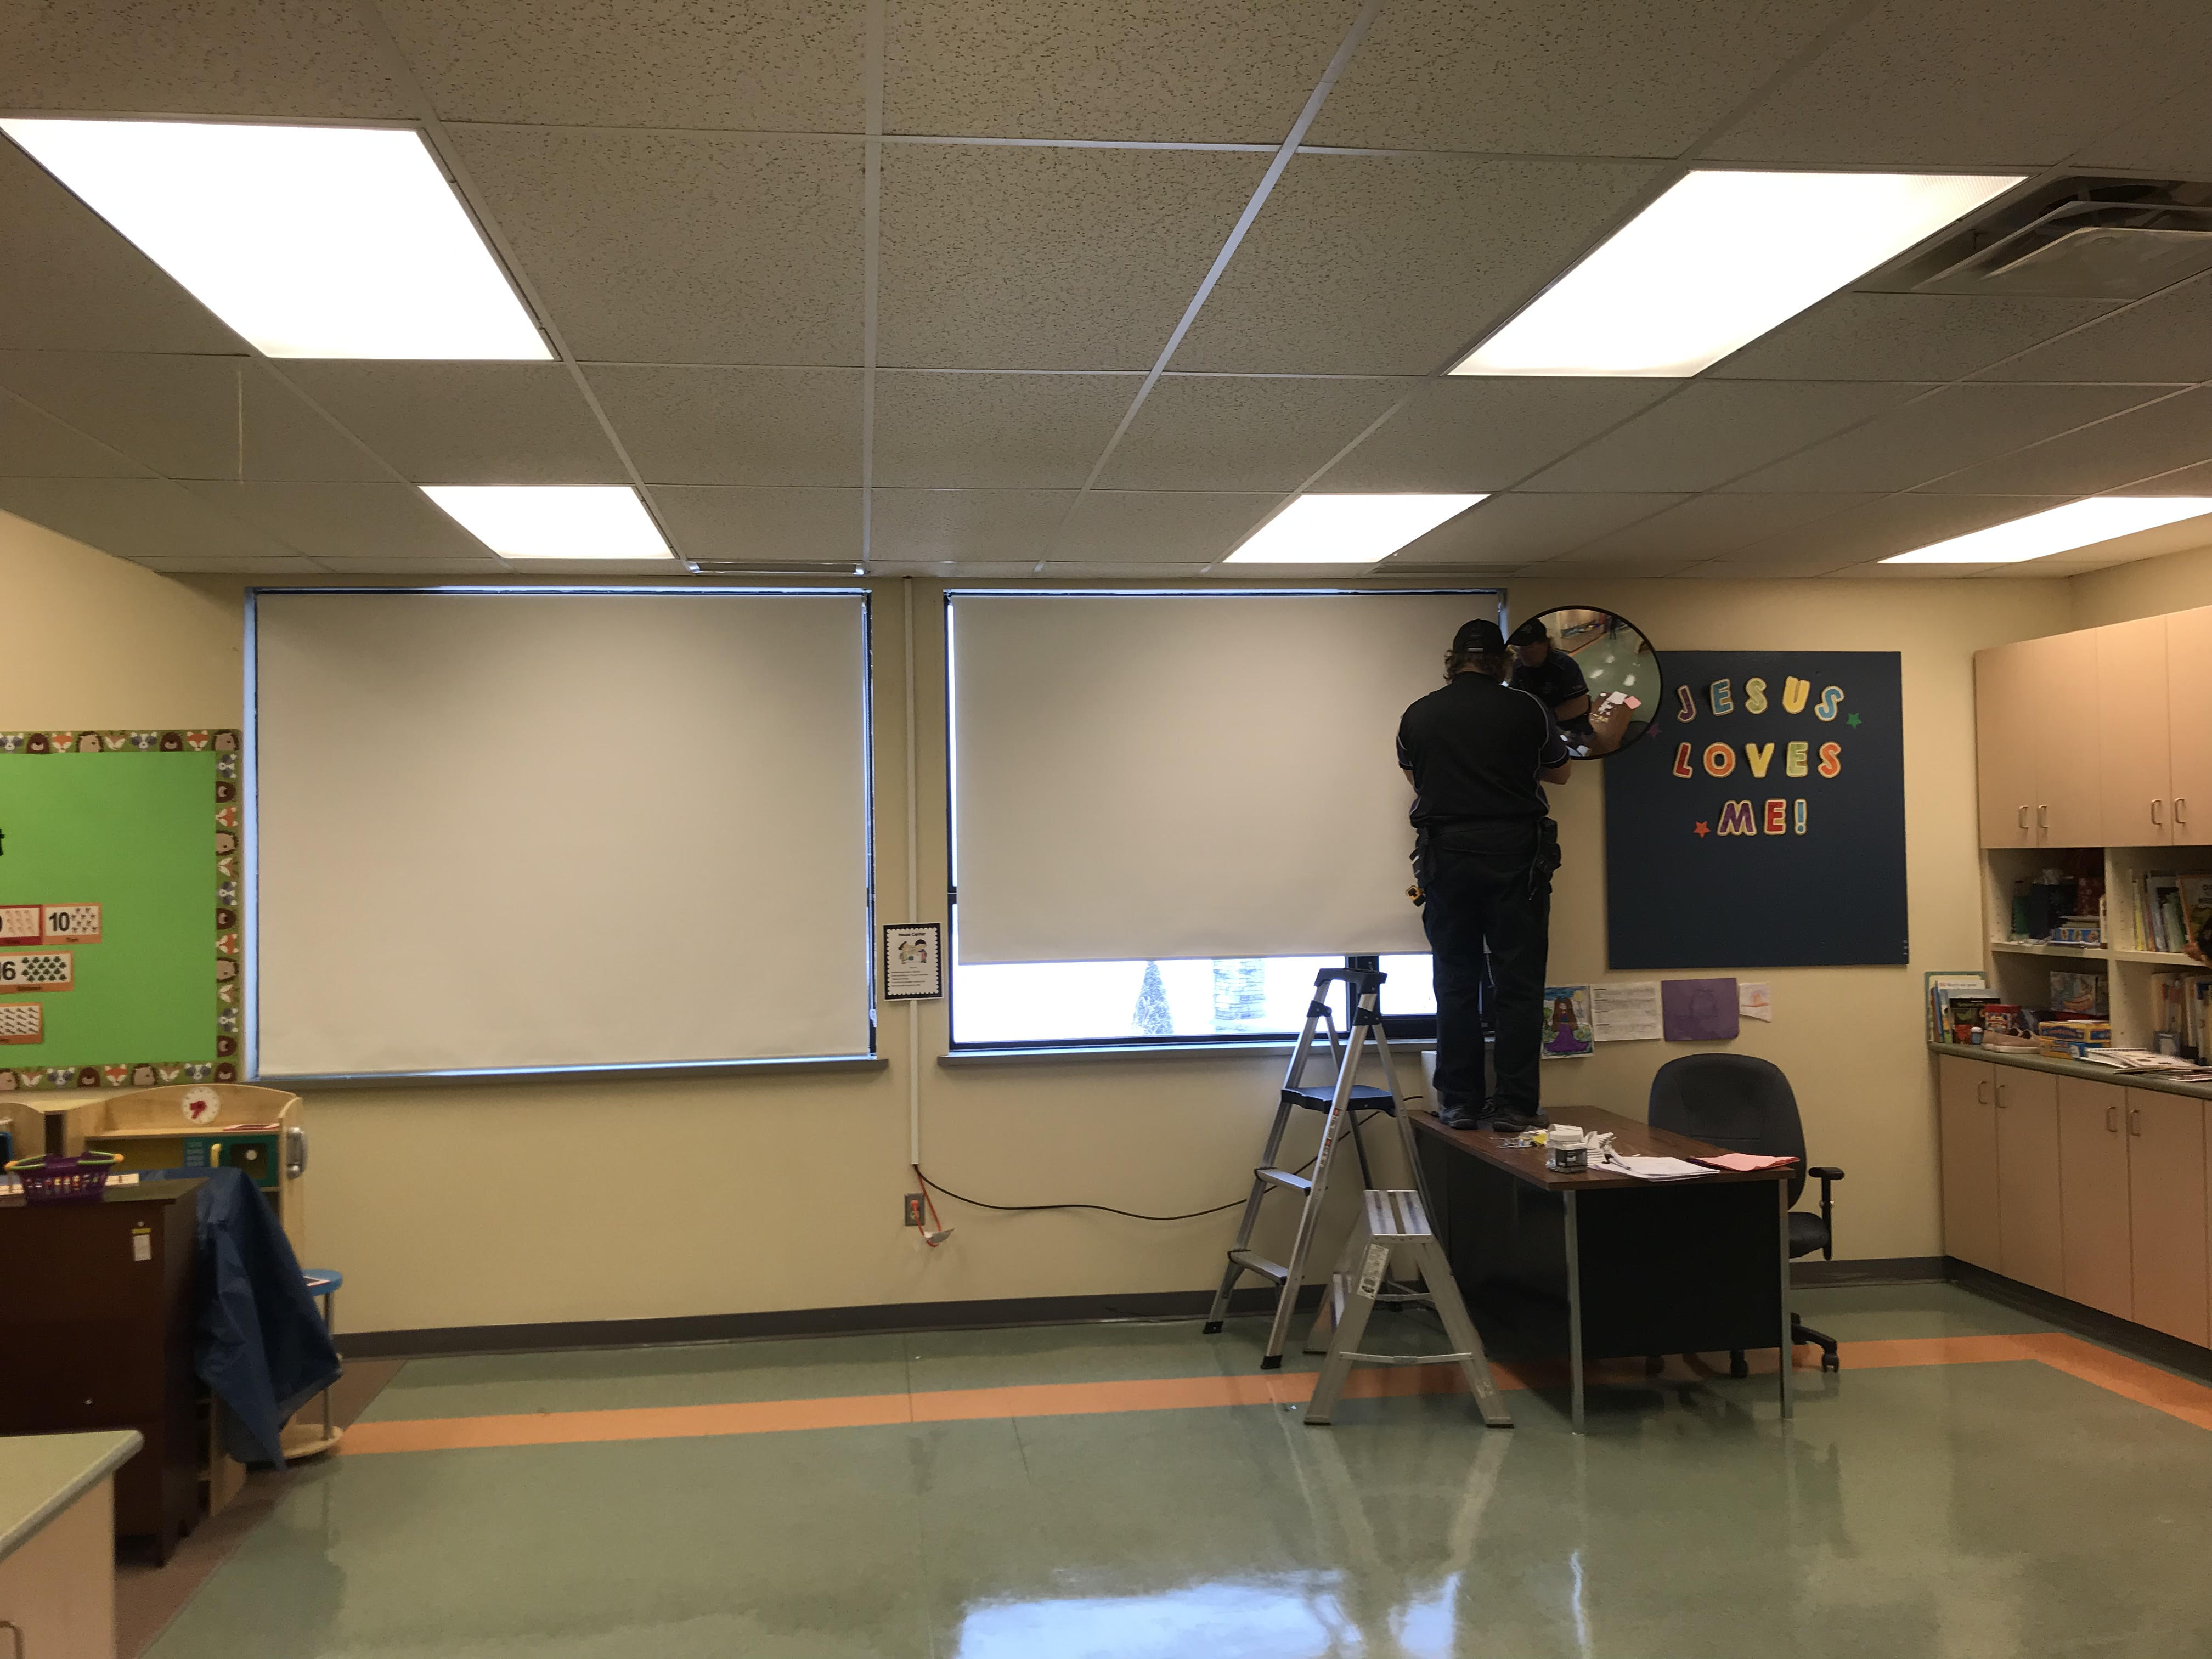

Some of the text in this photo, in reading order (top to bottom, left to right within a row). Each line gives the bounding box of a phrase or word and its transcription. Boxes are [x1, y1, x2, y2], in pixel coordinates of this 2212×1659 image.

[1677, 676, 1844, 723] JESUS
[1673, 741, 1842, 779] LOVES
[1717, 798, 1807, 836] ME!
[48, 912, 70, 931] 10
[0, 961, 16, 981] 6
